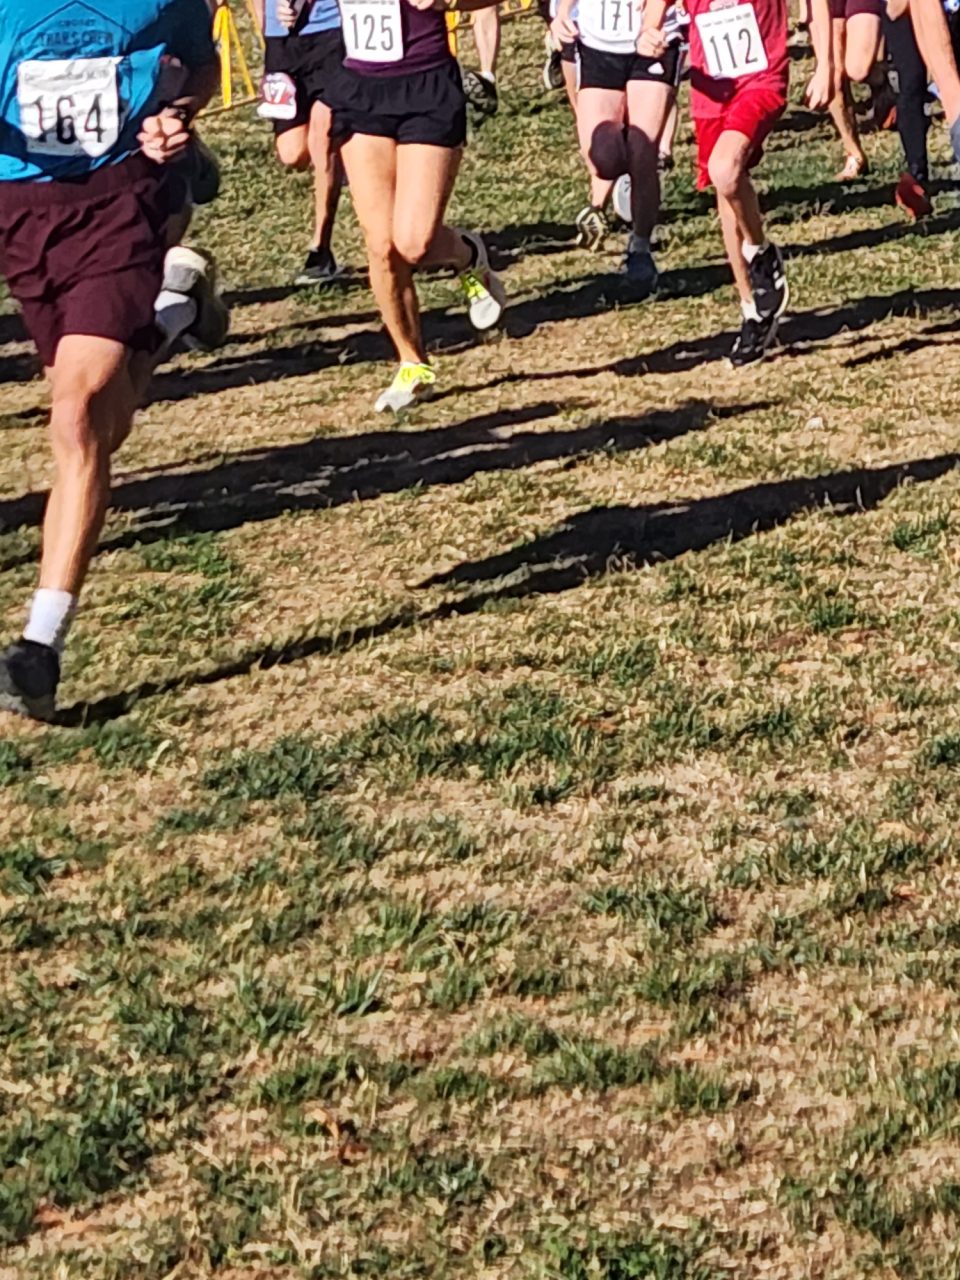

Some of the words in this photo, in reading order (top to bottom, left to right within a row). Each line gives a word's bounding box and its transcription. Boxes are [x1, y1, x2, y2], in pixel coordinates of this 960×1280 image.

[350, 13, 393, 51] 125
[600, 0, 633, 32] 171
[709, 28, 758, 73] 112
[33, 93, 105, 144] 164
